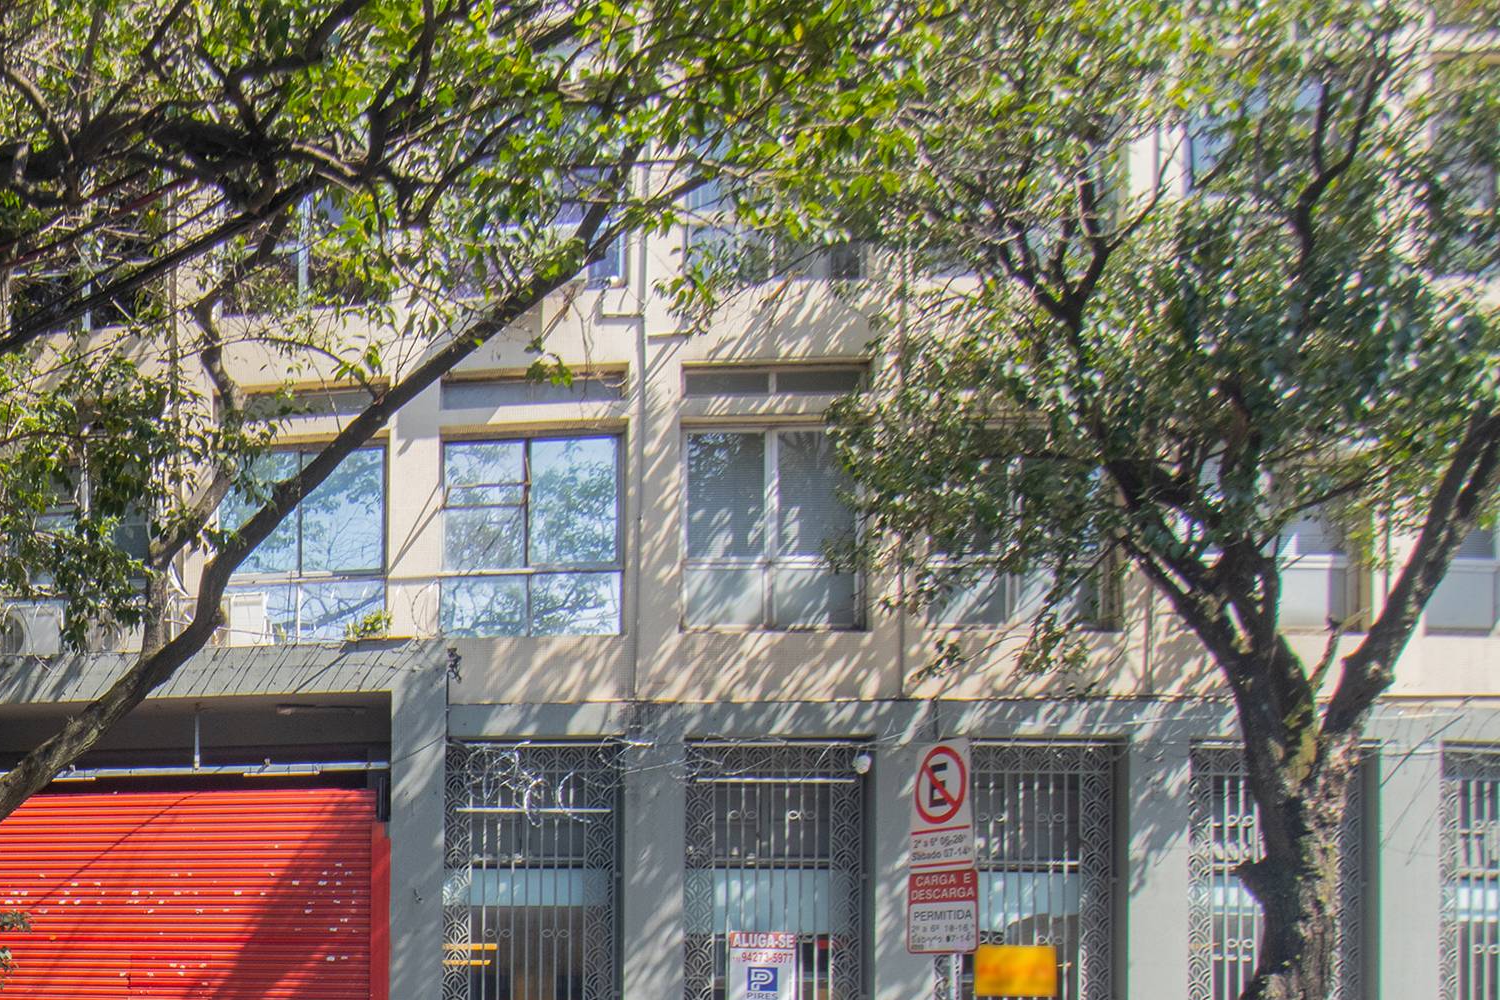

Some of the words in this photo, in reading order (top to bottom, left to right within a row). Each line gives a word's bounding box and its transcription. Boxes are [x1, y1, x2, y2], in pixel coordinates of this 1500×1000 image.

[915, 873, 956, 888] CARGA
[963, 872, 972, 884] E
[911, 886, 975, 901] DESCARGA
[913, 909, 972, 921] PERMITIDA
[732, 933, 795, 948] ALUGA-SE
[747, 992, 779, 1000] PIRES
